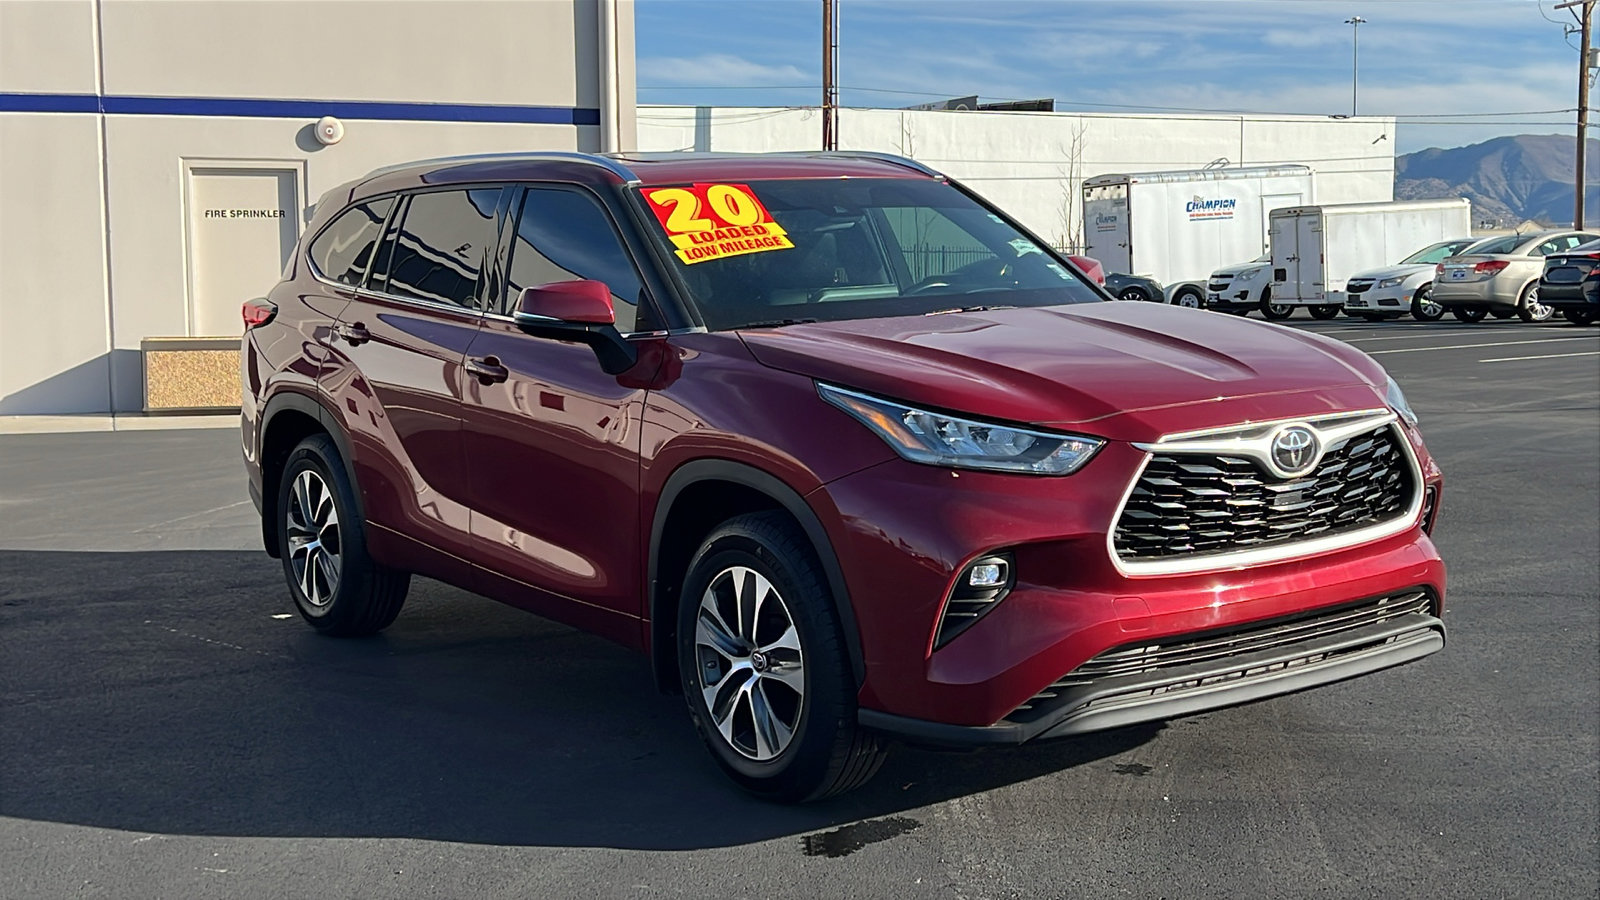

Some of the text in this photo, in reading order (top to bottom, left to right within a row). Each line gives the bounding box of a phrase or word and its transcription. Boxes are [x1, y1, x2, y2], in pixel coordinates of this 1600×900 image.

[205, 209, 286, 218] FIRE SPRINKLER
[649, 184, 765, 233] 20
[1186, 199, 1236, 212] CHAMPION
[688, 224, 769, 245] LOADED
[684, 235, 784, 260] LOW MILEAGE
